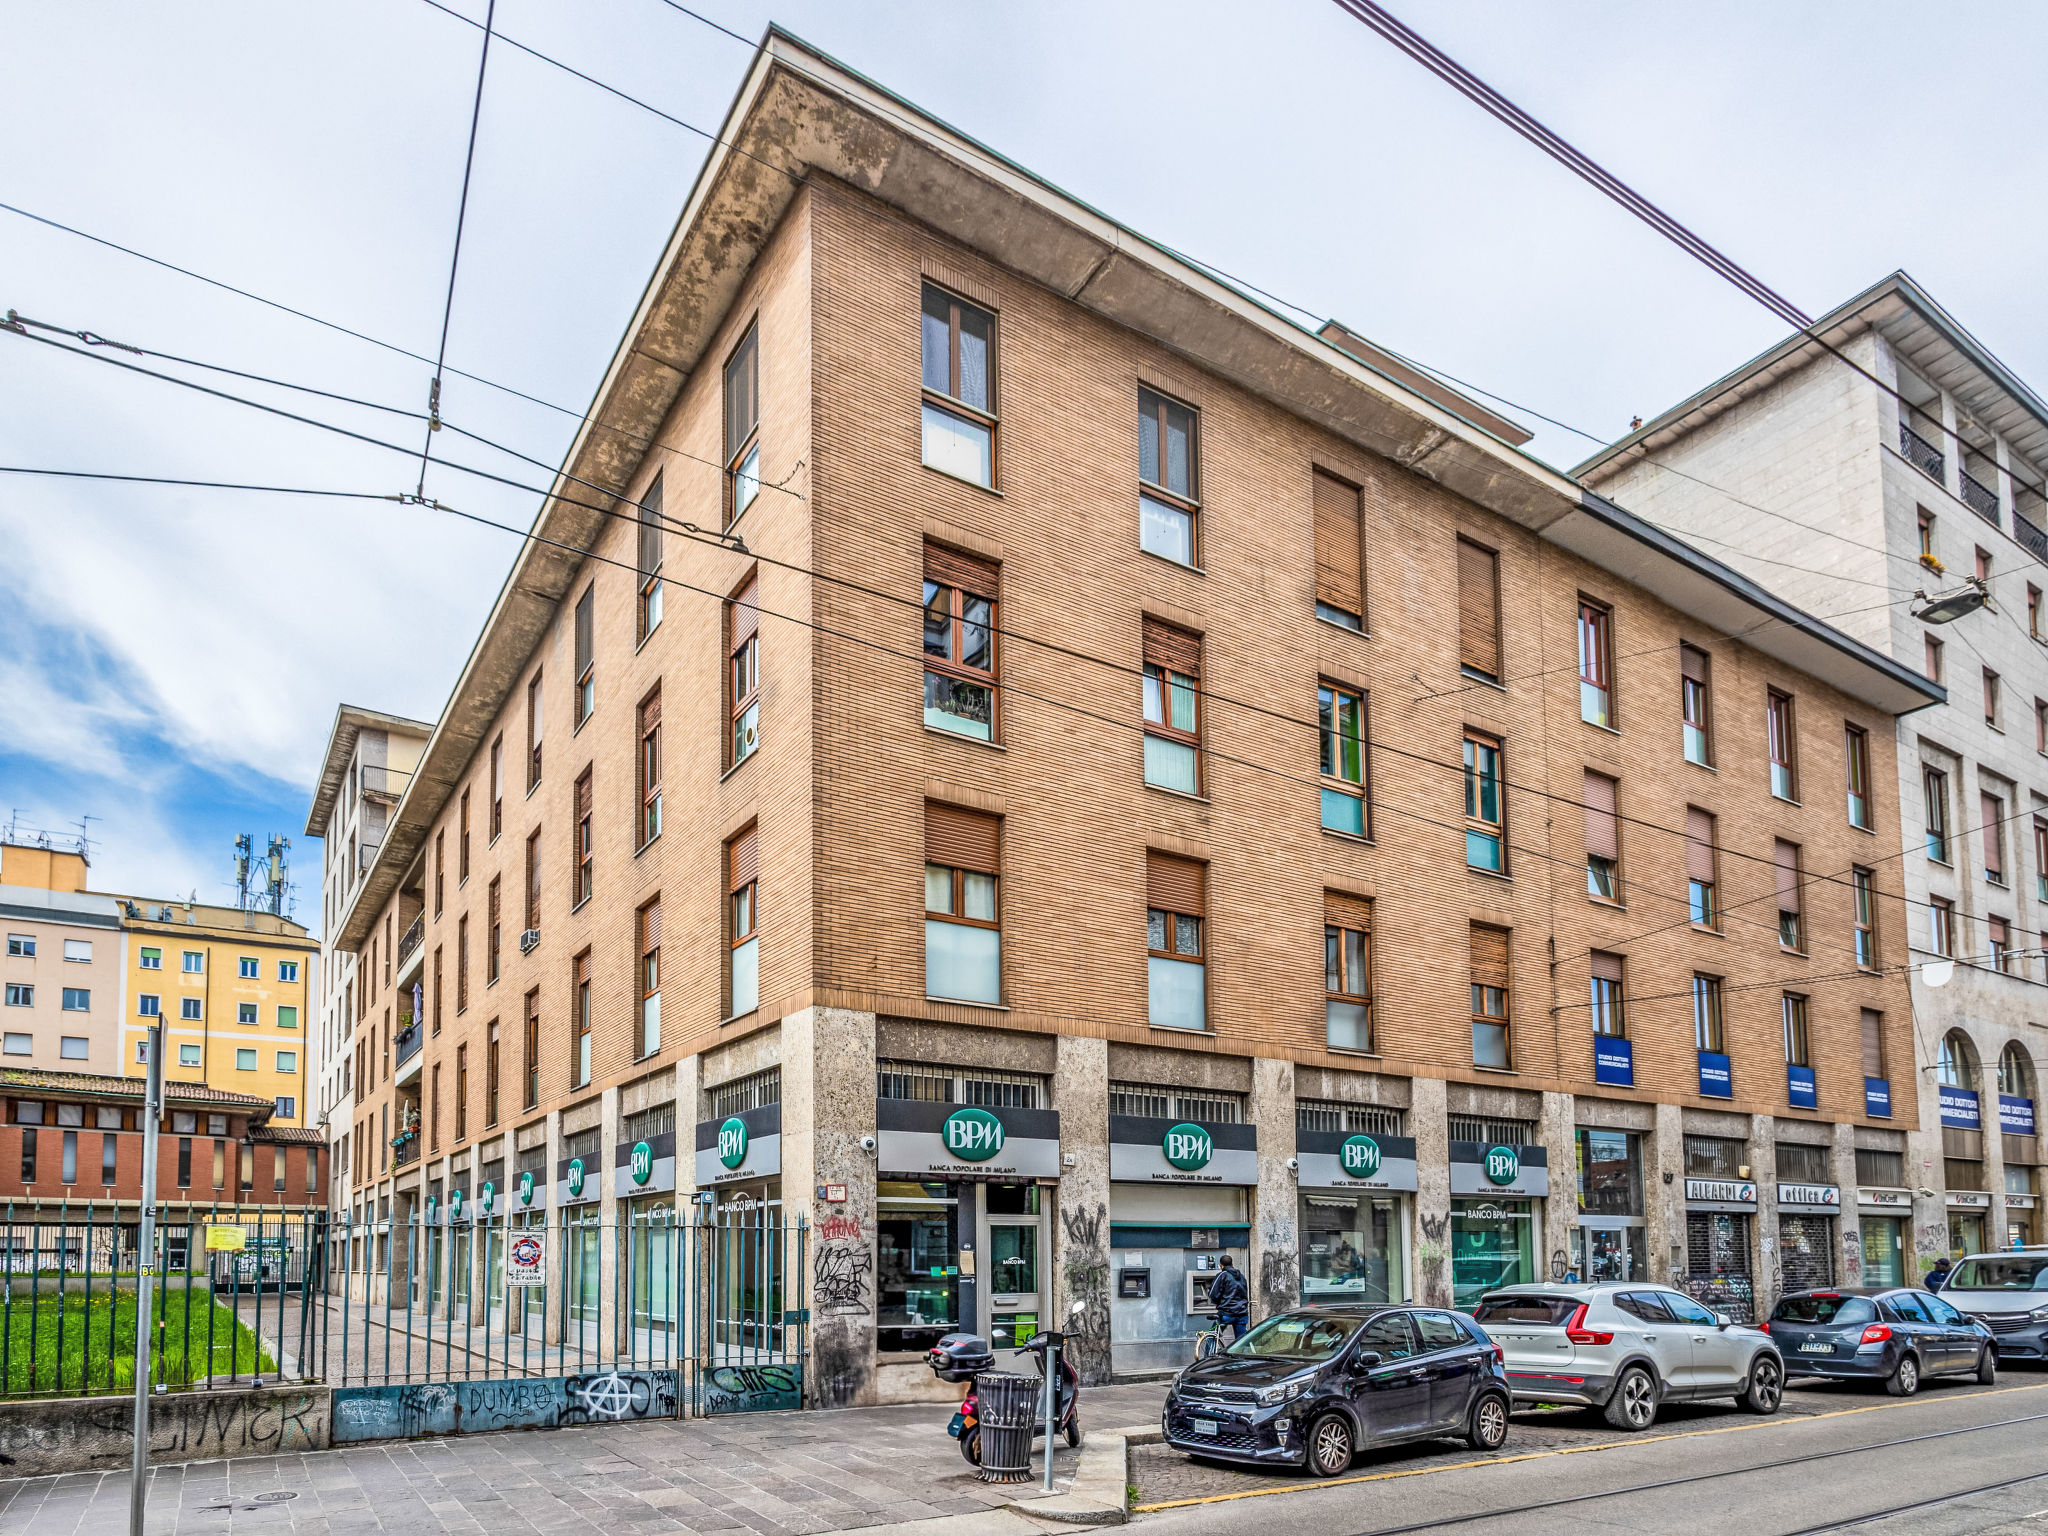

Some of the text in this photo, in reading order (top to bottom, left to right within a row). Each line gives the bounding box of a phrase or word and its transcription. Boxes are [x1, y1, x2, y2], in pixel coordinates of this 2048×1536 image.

[1940, 1096, 1978, 1109] UDIO DOTTORI
[1999, 1104, 2011, 1114] UDIO
[718, 1127, 744, 1159] BPM
[949, 1119, 1001, 1149] BPM
[1168, 1133, 1211, 1160] BPM
[1345, 1144, 1380, 1168] BPM
[630, 1150, 649, 1176] BPM
[929, 1164, 951, 1172] BANCA
[952, 1165, 983, 1173] POPOLARE
[1489, 1155, 1518, 1177] BPM
[567, 1167, 583, 1188] BPM
[724, 1199, 757, 1212] BANCO BPM
[1467, 1210, 1507, 1220] BANCO BPM
